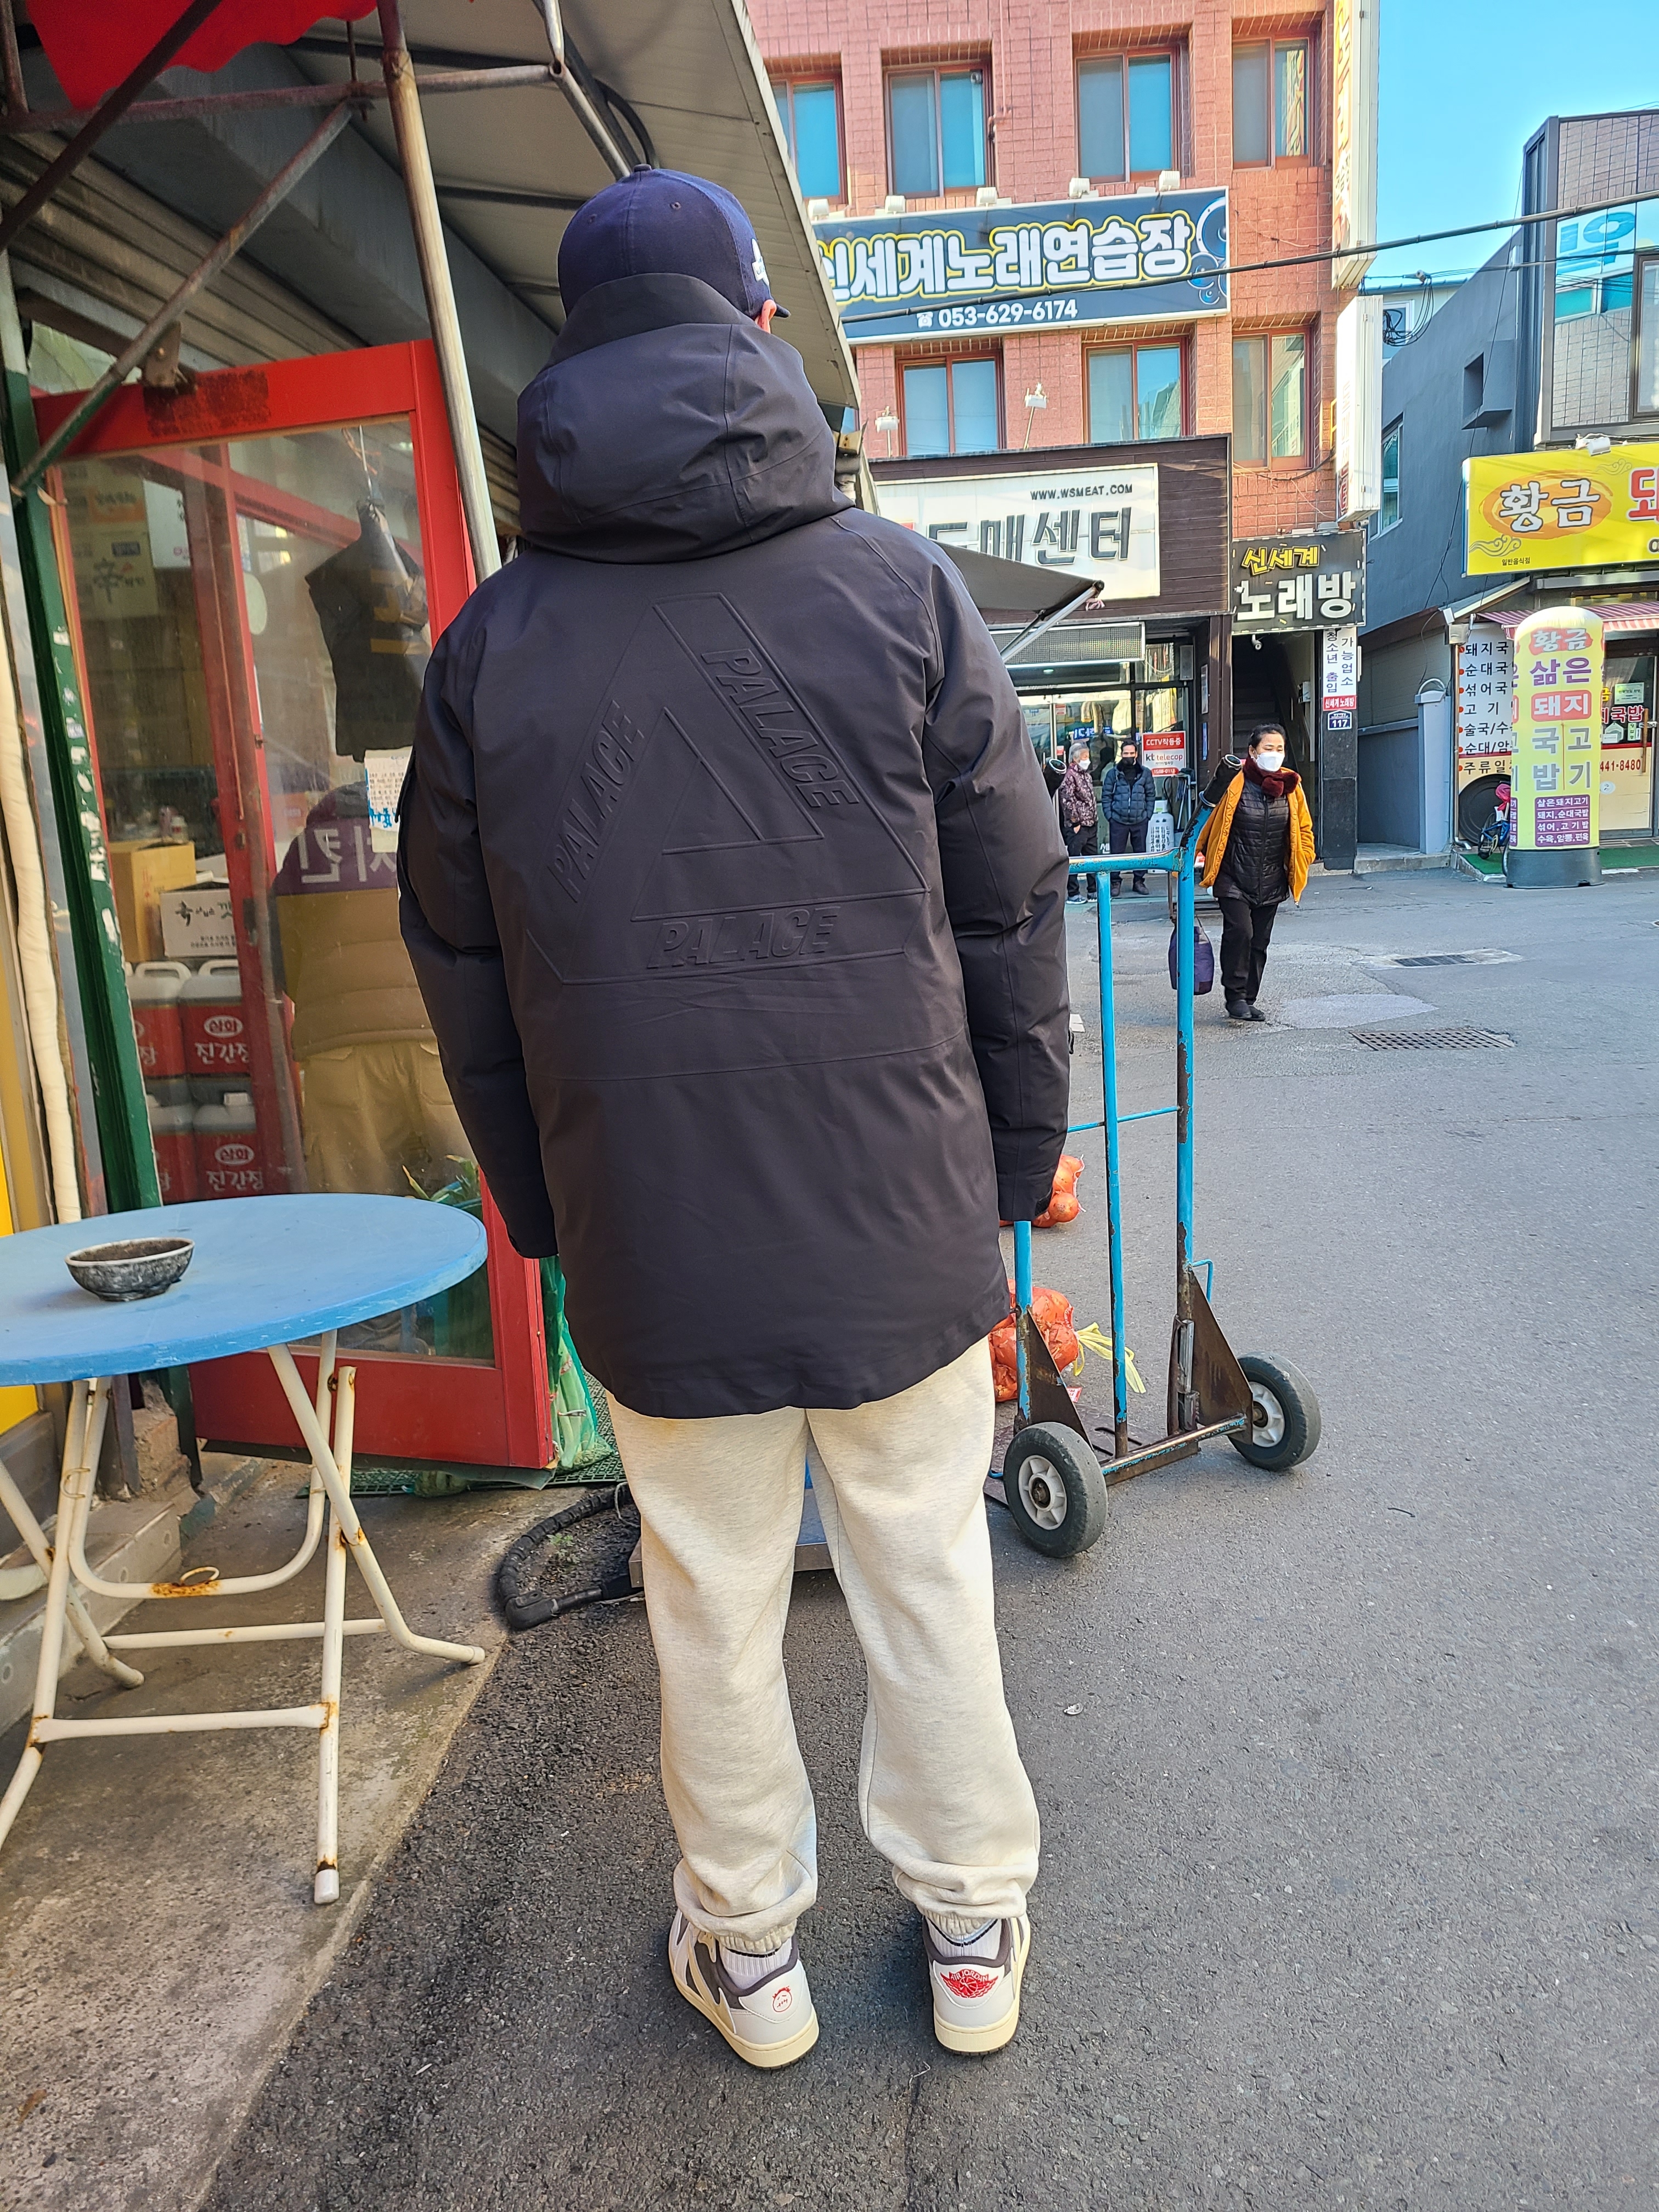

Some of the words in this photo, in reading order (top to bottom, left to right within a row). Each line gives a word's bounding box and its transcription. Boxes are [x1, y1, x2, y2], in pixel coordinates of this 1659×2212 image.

[938, 300, 1078, 328] 053-629-6174
[1030, 483, 1133, 500] WWW.WSMEAT.COM
[1499, 477, 1600, 533] 황금
[1242, 545, 1320, 575] 신세계
[1502, 556, 1531, 566] 일반음식점
[1237, 571, 1356, 621] 노래방
[1326, 631, 1339, 663] 청소년
[1533, 628, 1587, 652] 황금
[1340, 636, 1354, 686] 가능업소
[1530, 657, 1592, 686] 삶은
[1325, 672, 1339, 693] 출입
[1533, 693, 1588, 716] 돼지
[701, 648, 860, 808] PALACE
[1146, 737, 1182, 746] CCTV작동중
[1146, 753, 1155, 761] kt
[548, 700, 644, 903] PALACE
[1537, 797, 1588, 808] 삶은돼지고기
[647, 906, 840, 969] PALACE
[961, 1969, 988, 1982] JORDAN
